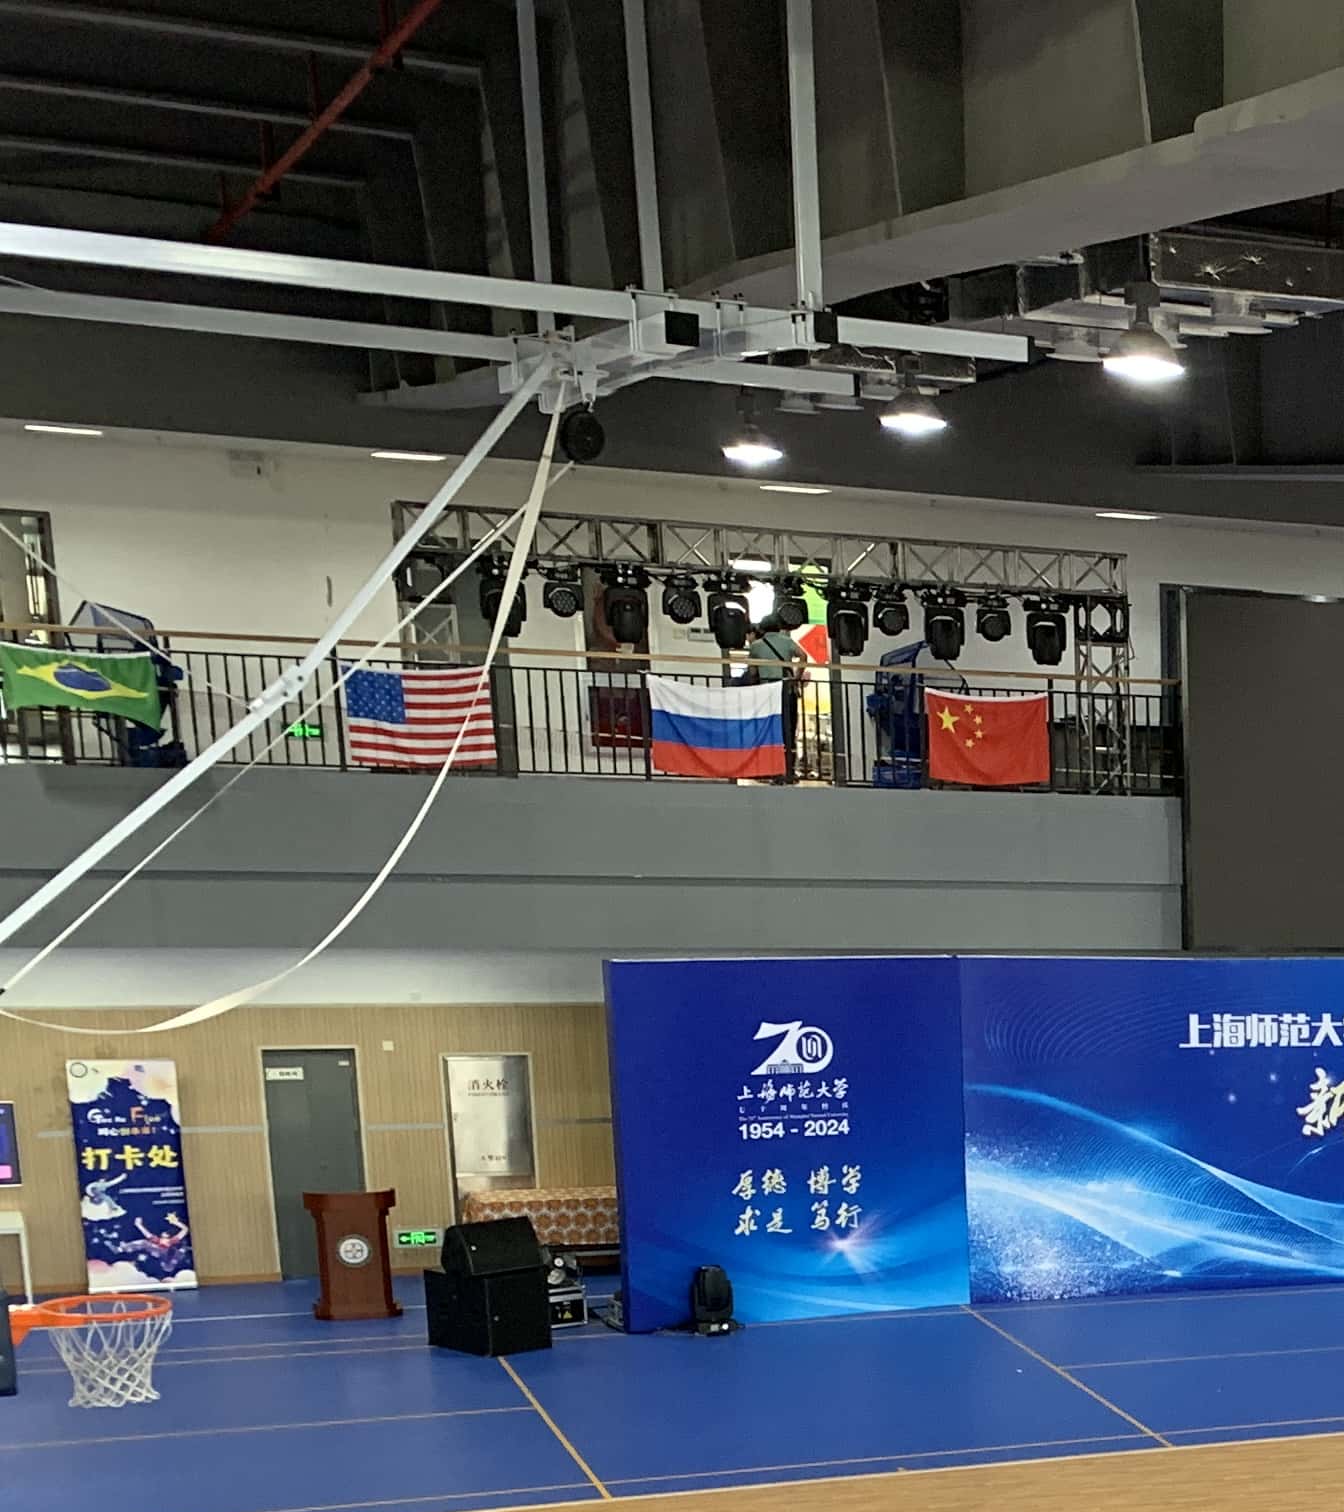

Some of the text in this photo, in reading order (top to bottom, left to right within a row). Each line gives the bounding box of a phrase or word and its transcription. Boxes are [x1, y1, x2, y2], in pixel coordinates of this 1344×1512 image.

[737, 1078, 849, 1104] 上海师范大学
[739, 1122, 785, 1140] 1954
[804, 1119, 850, 1137] 2024
[81, 1145, 179, 1171] 打卡处
